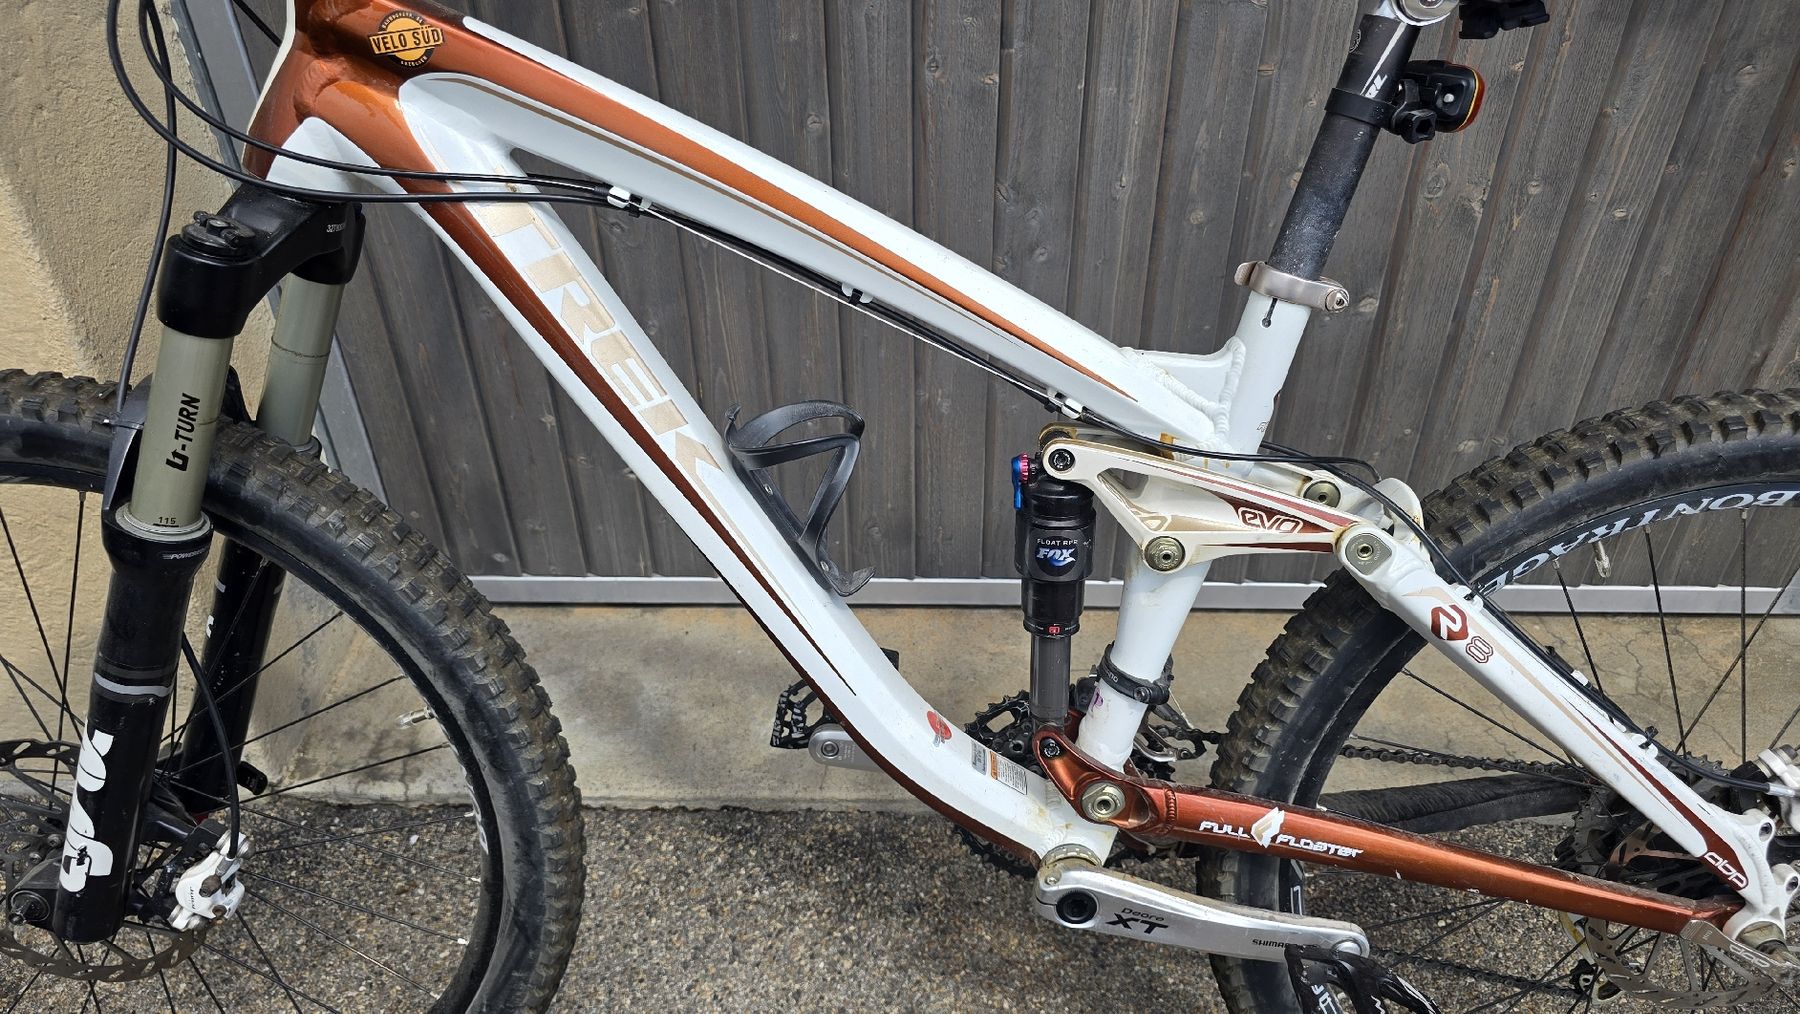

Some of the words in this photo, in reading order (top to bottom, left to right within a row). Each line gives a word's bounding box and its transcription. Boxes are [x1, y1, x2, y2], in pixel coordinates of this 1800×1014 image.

[372, 33, 407, 52] VELO
[412, 25, 440, 46] SÜD
[487, 163, 724, 500] TREK
[165, 392, 200, 471] U-TURN
[158, 516, 177, 525] 115
[1037, 538, 1061, 547] FLOAT
[1477, 490, 1800, 599] BONTRAGE
[1036, 547, 1076, 562] FOX
[1199, 820, 1251, 839] FULL
[1105, 912, 1169, 935] XT
[1121, 907, 1165, 922] Deore
[1252, 938, 1286, 949] SHIMA
